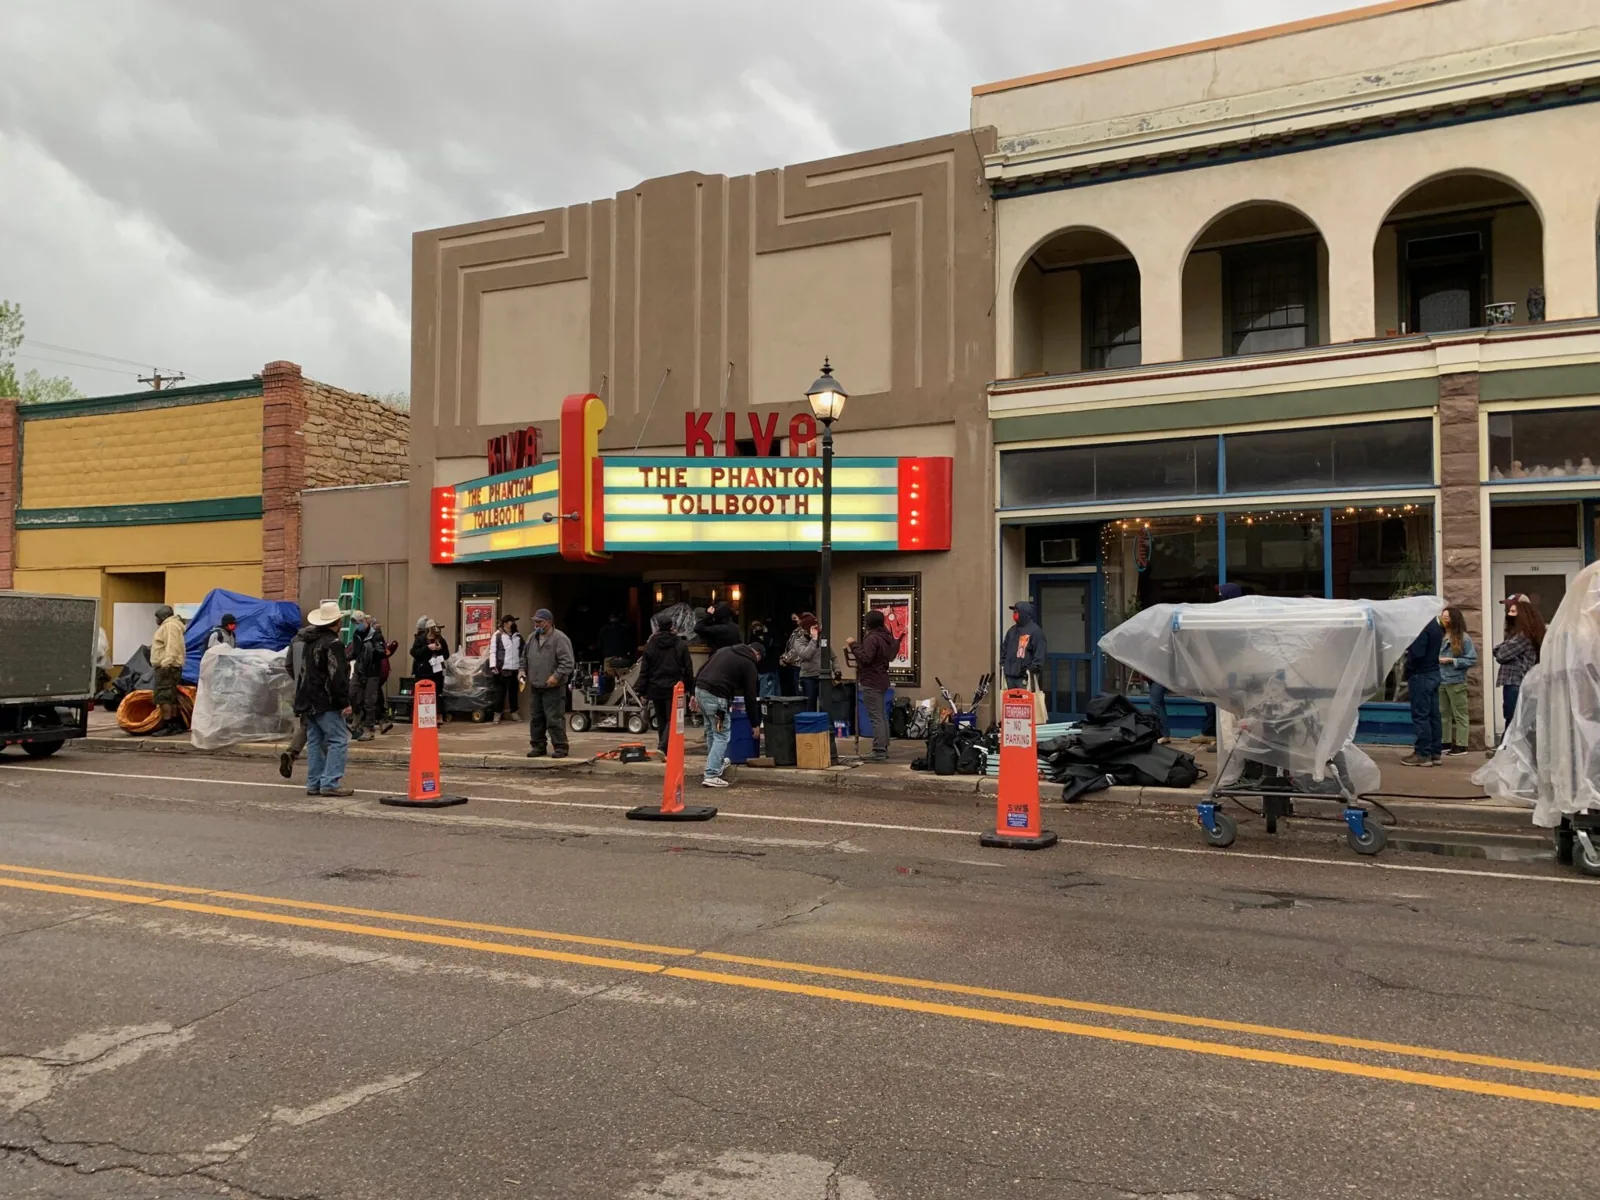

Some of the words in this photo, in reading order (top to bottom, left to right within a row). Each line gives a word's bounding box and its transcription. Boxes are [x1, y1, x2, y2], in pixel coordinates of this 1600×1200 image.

[685, 411, 817, 457] KIVA
[487, 425, 540, 476] KIVA
[639, 467, 688, 488] THE
[468, 488, 482, 507] THE
[489, 475, 534, 503] PHANTOM
[662, 494, 810, 515] TOLLBOOTH
[473, 503, 525, 529] TOLLBOOTH
[1013, 721, 1022, 731] NO
[1005, 734, 1030, 745] PARKING
[1008, 804, 1029, 812] SWS
